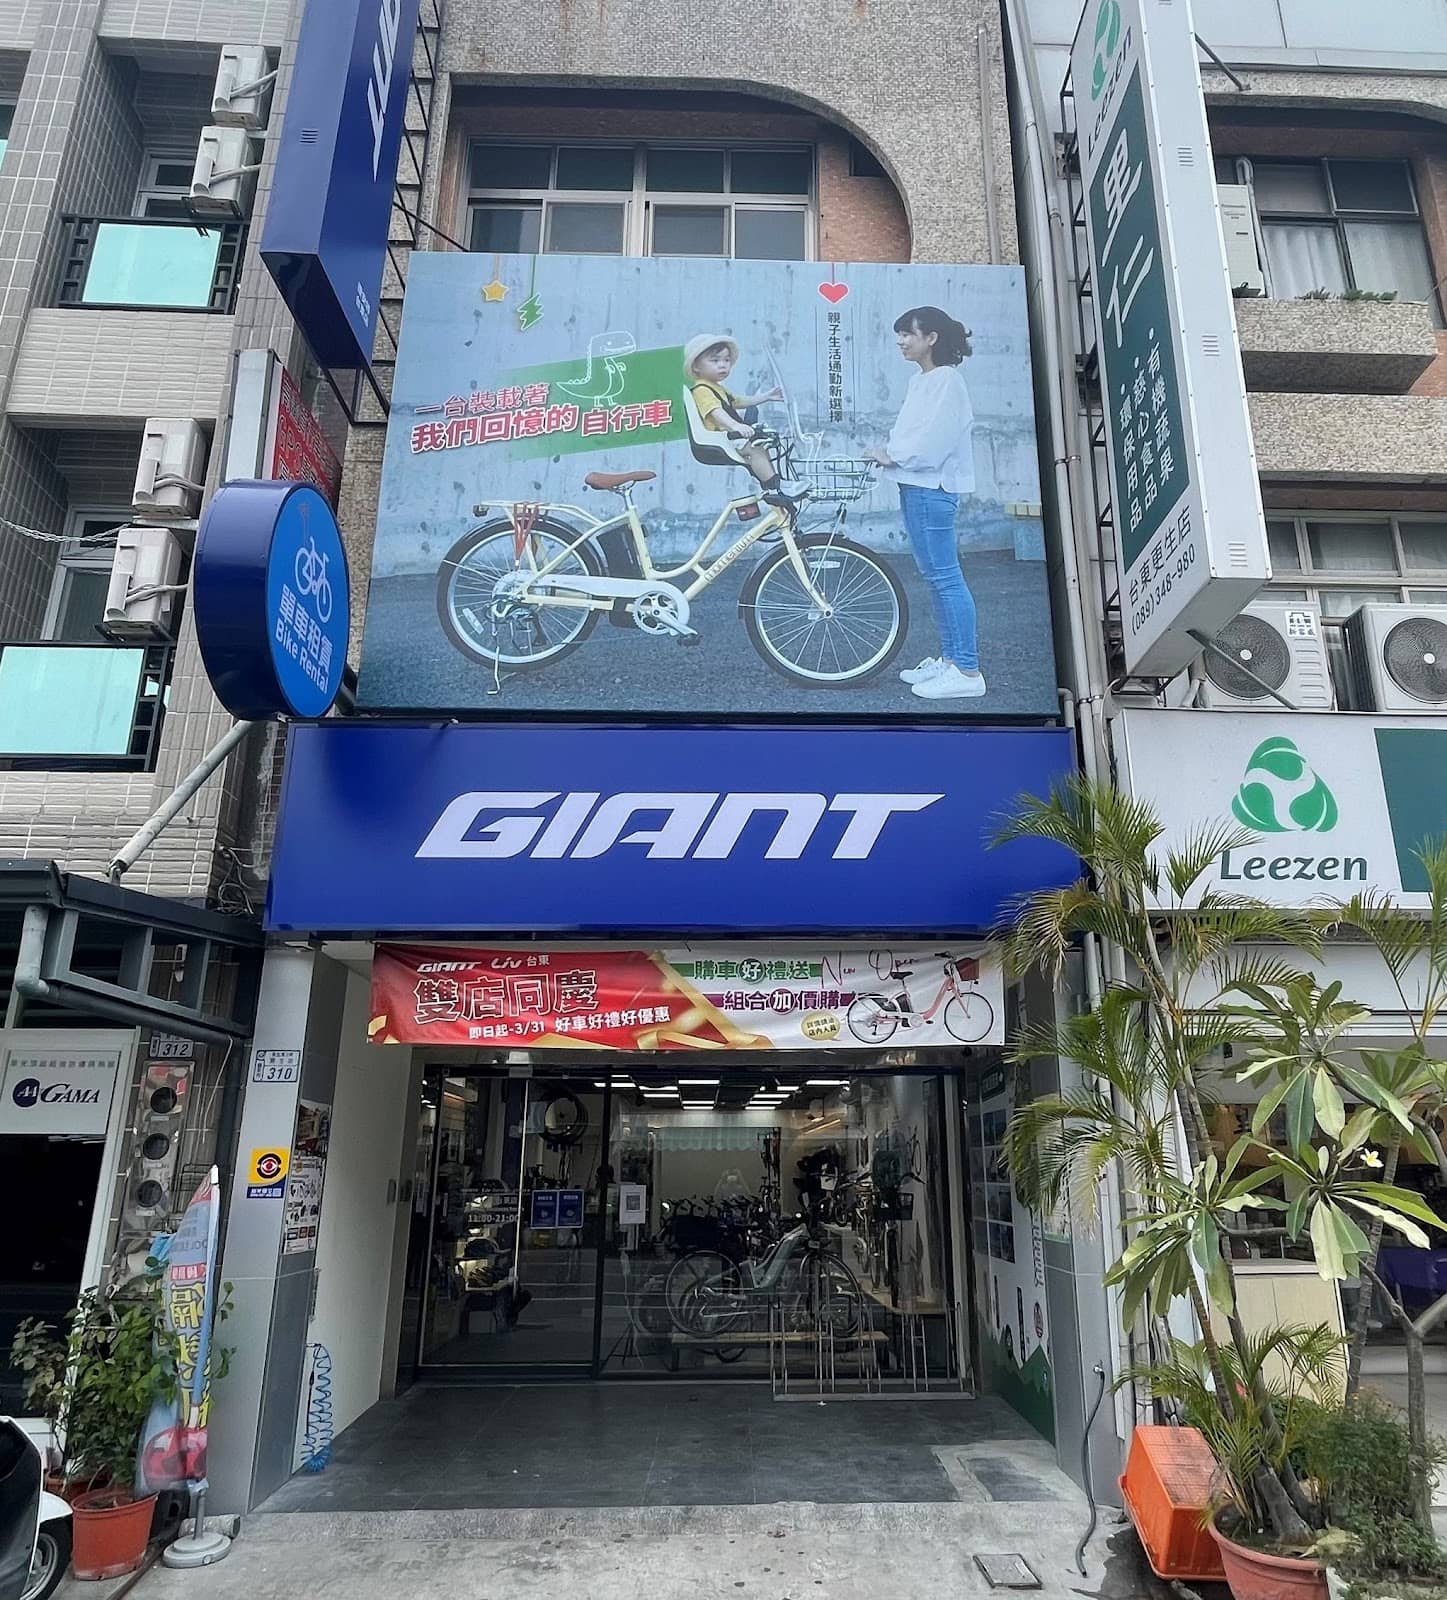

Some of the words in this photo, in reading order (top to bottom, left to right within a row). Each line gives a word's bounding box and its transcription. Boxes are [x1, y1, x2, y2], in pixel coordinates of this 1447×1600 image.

[1102, 128, 1154, 348] 里仁
[827, 311, 843, 423] 親子生活通勤新選擇
[410, 403, 579, 454] 我們回憶的
[582, 399, 673, 437] 自行車
[415, 382, 551, 418] 一台裝載著
[1147, 342, 1175, 487] 有機蔬果
[1119, 394, 1143, 534] 環保用品
[1132, 369, 1158, 512] 慈心食品
[1129, 504, 1192, 608] 台東更生店
[1131, 543, 1196, 637] (089)348-980
[275, 617, 299, 660] Bike
[299, 645, 329, 695] Rental
[279, 583, 333, 676] 單車租賃
[414, 790, 947, 860] GIANT
[1219, 849, 1368, 881] Leezen
[416, 960, 482, 974] GIANT
[490, 957, 523, 970] Liv
[526, 954, 551, 968] 台東
[692, 958, 812, 984] 購車好禮送
[411, 968, 600, 1025] 雙店同慶
[469, 1020, 546, 1041] 即日起-3/31
[554, 1006, 672, 1034] 好車好禮好優惠
[723, 989, 842, 1013] 組合加價購
[162, 1043, 189, 1056] 312
[267, 1067, 293, 1080] 310
[40, 1083, 101, 1104] GAMA
